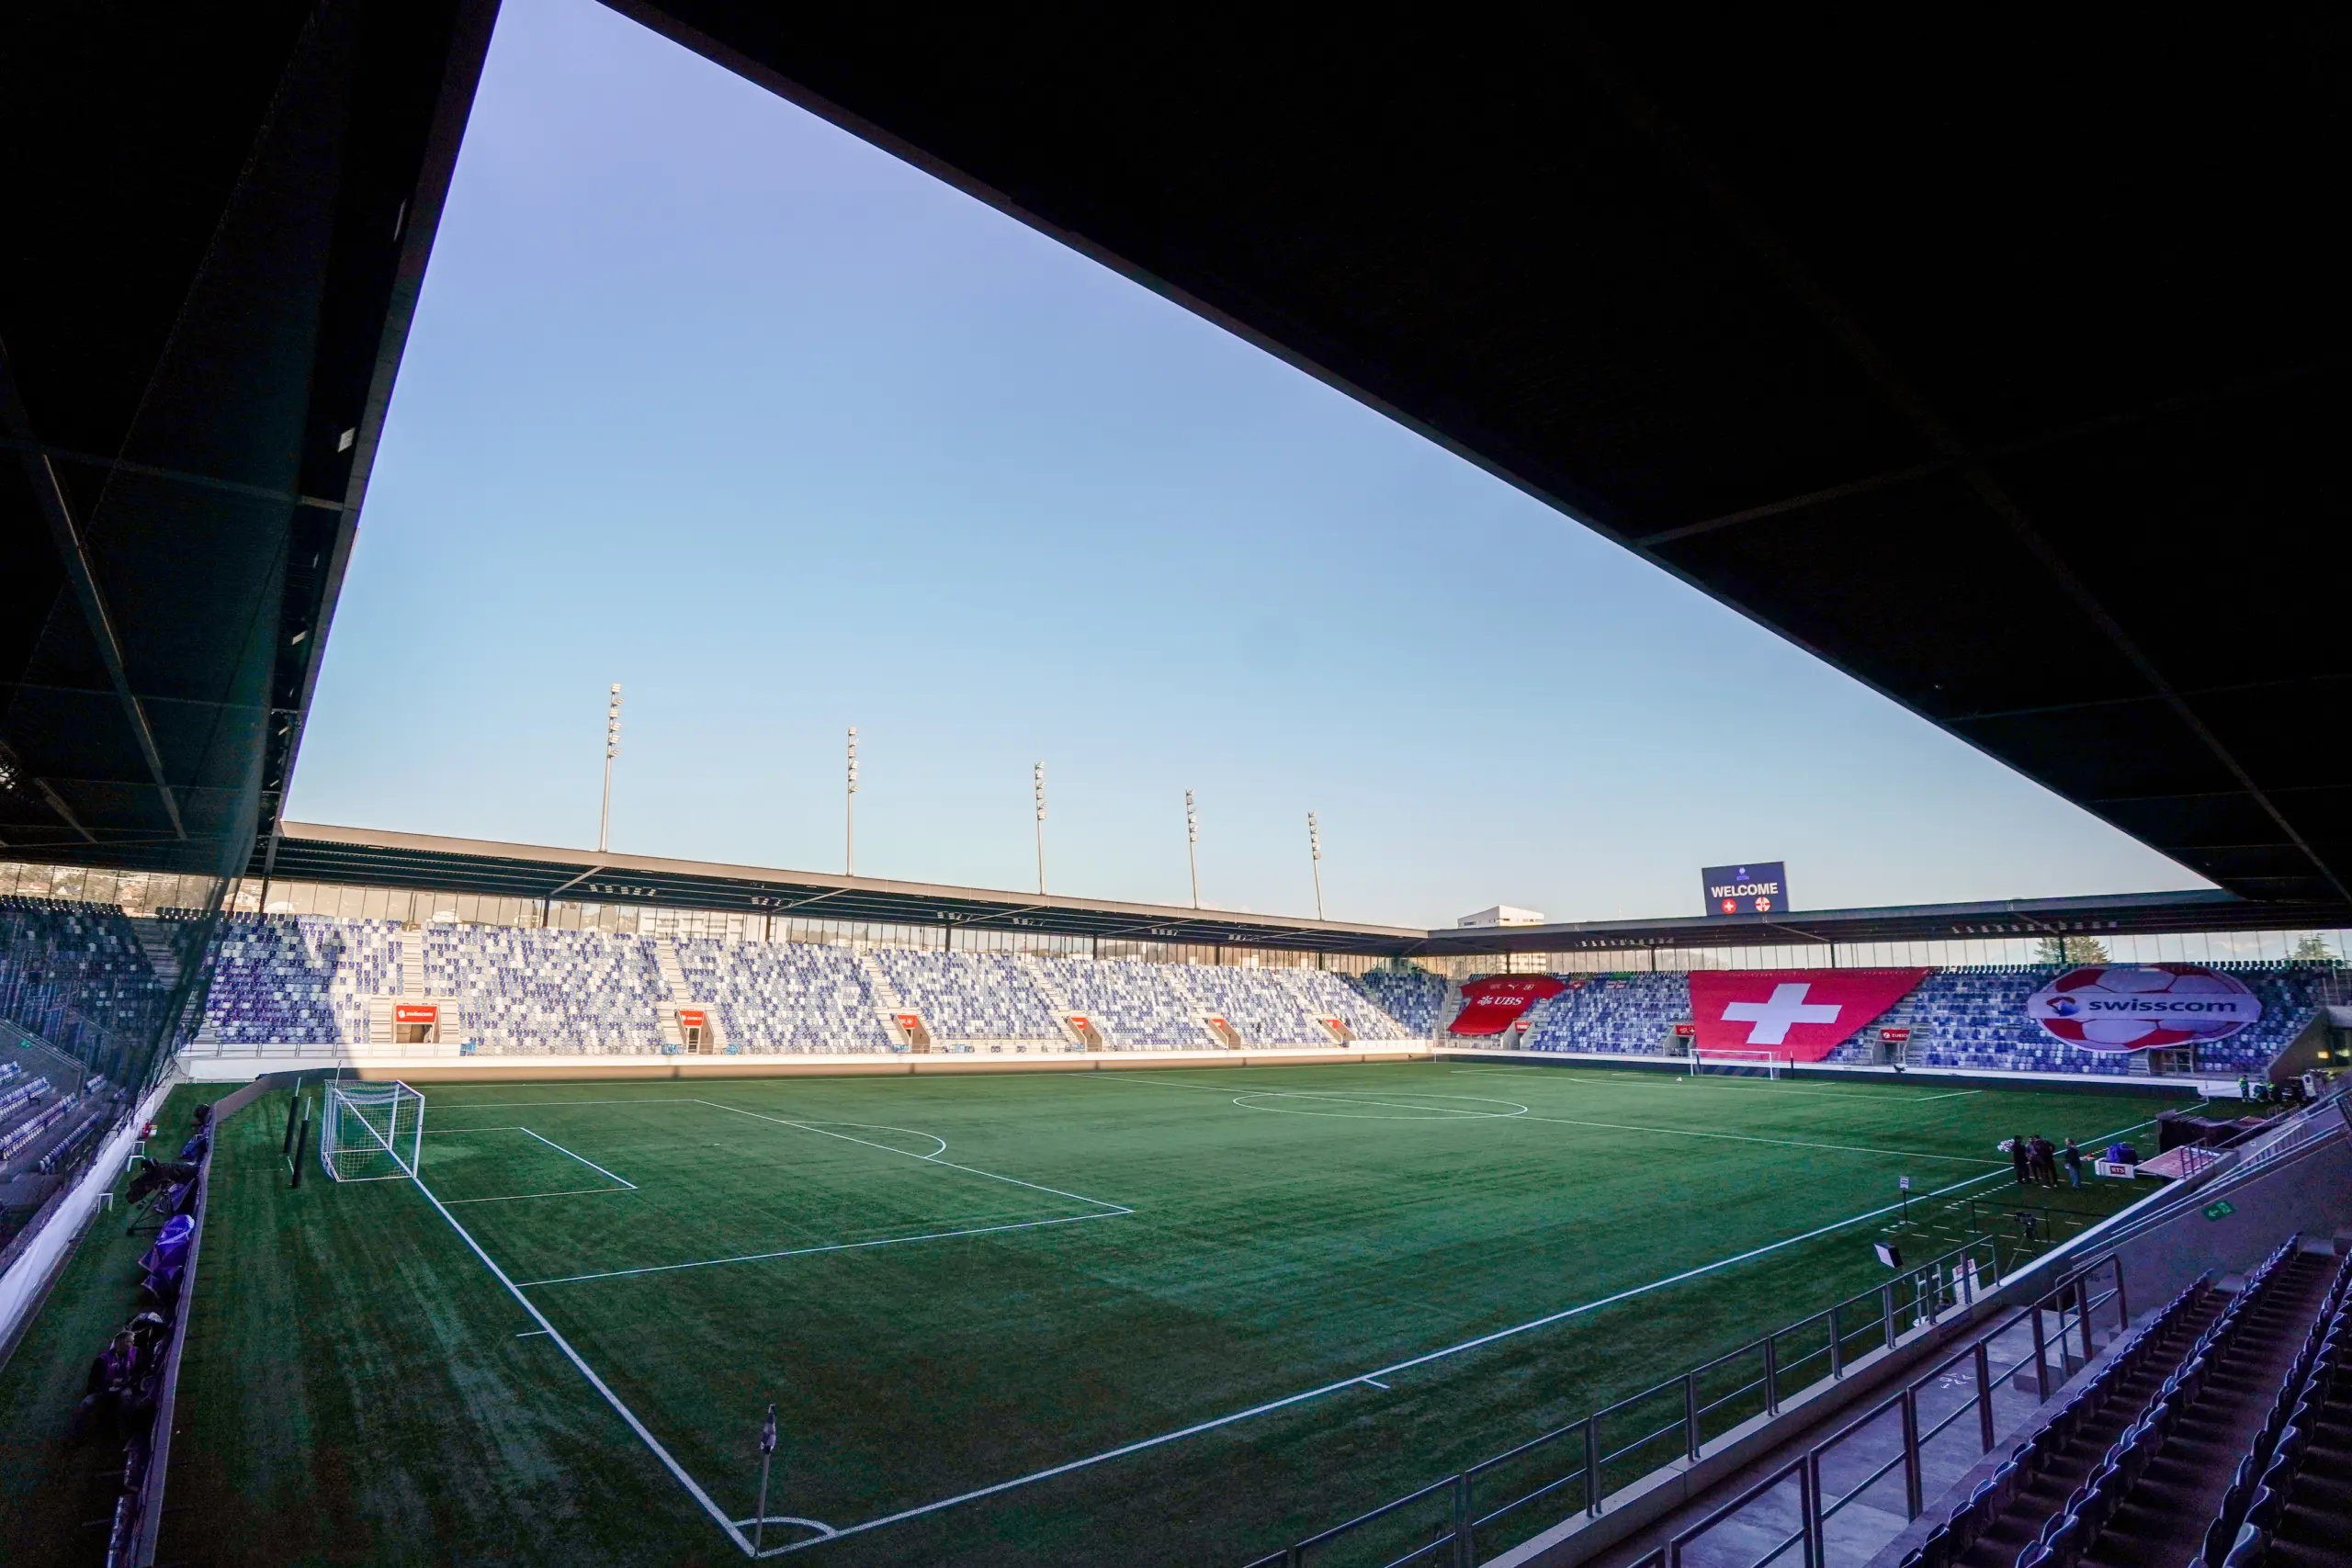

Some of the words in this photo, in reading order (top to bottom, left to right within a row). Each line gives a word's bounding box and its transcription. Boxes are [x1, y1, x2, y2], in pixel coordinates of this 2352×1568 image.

[1711, 883, 1779, 897] WELCOME
[1494, 997, 1524, 1006] UBS
[2089, 998, 2237, 1012] swisscom
